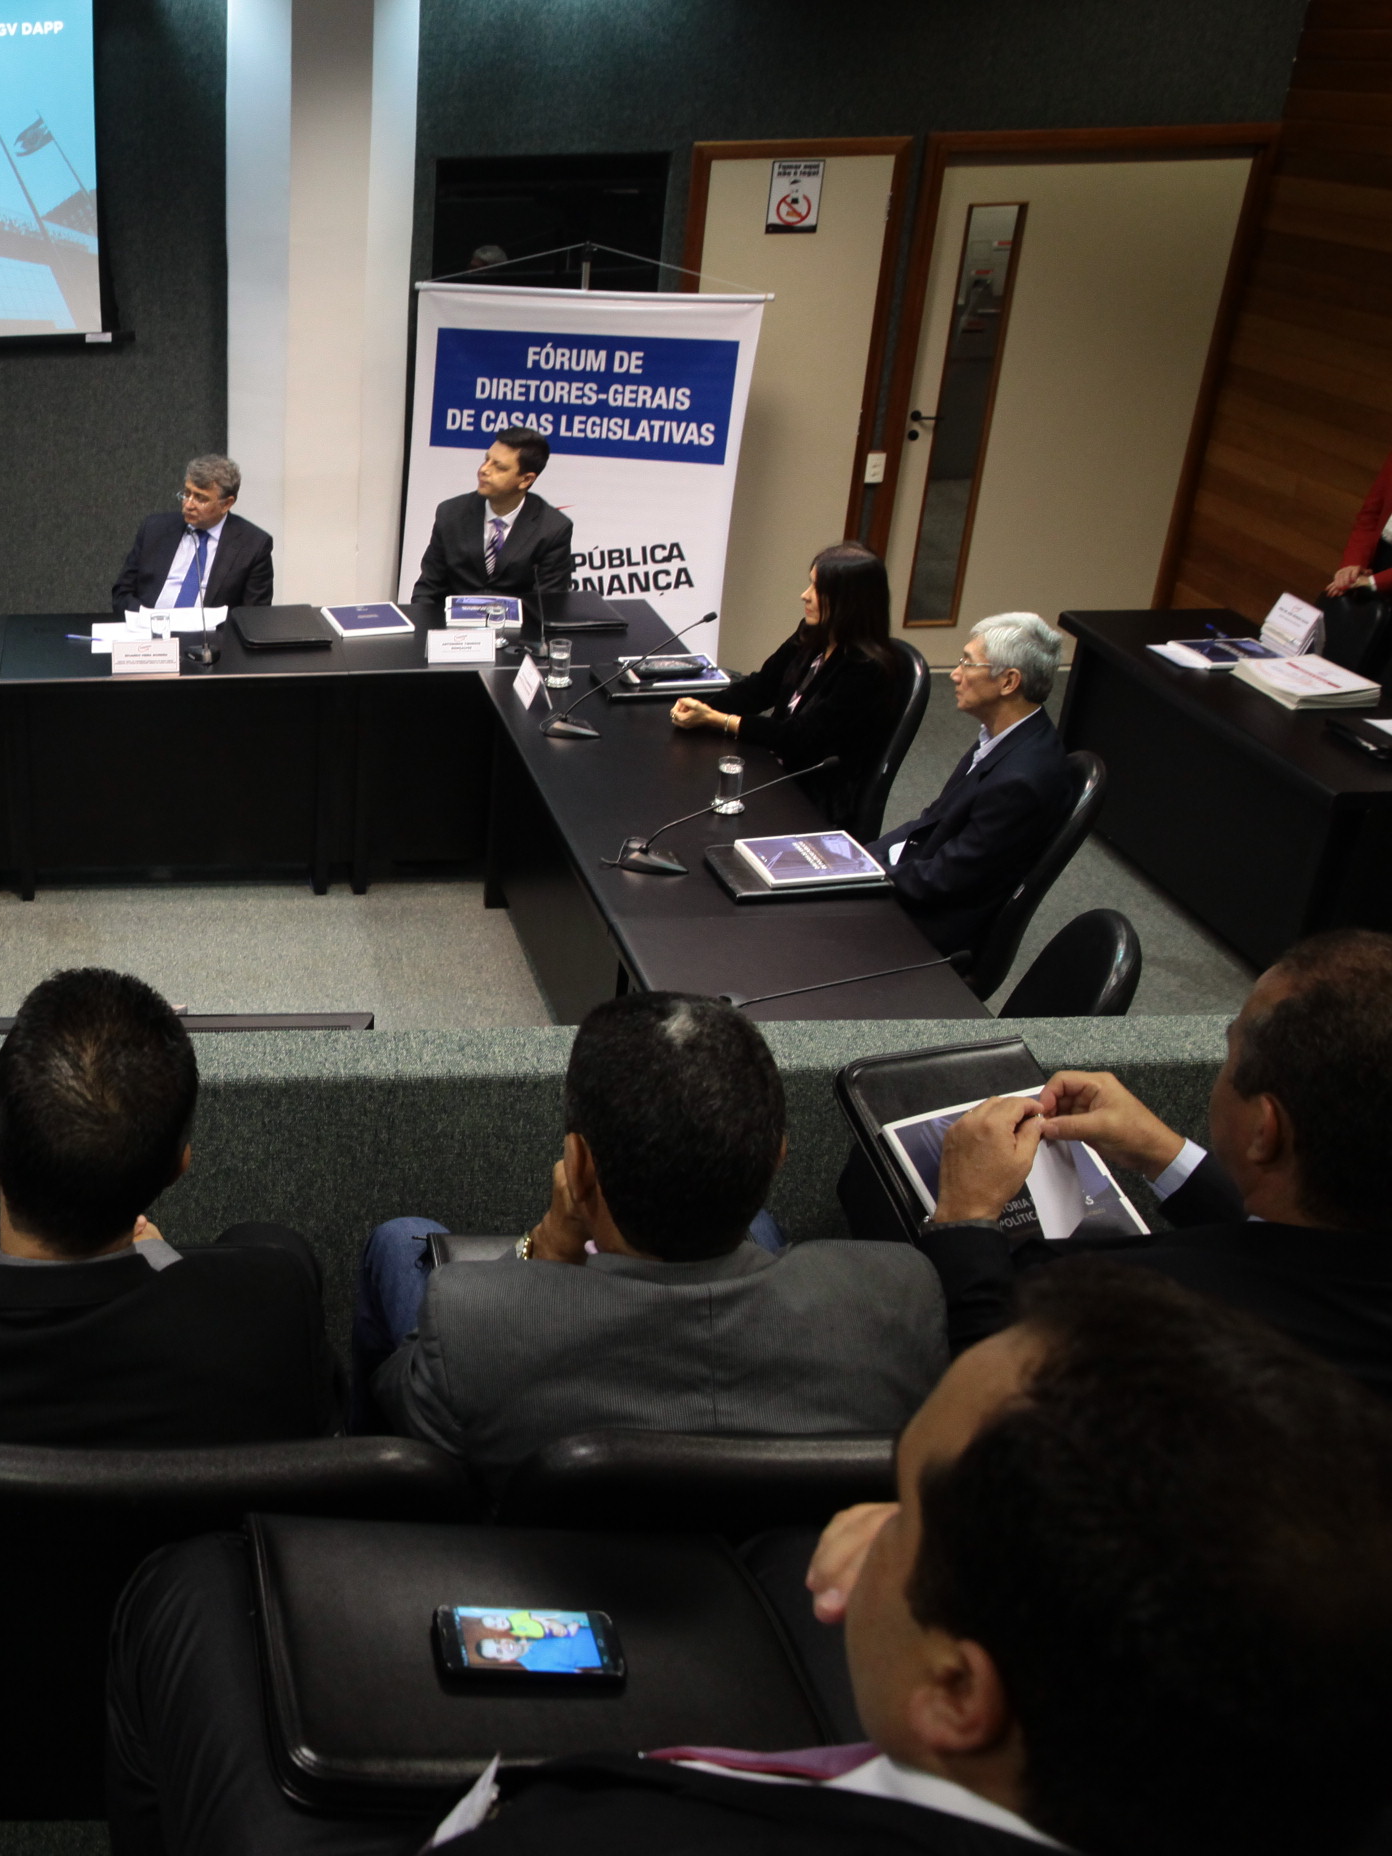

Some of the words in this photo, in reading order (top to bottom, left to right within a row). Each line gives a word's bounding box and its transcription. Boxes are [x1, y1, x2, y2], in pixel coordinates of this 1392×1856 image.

[21, 20, 64, 36] DAPP
[526, 342, 607, 373] FÓRUM
[613, 351, 644, 374] DE
[475, 377, 691, 411] DIRETORES-GERAIS
[446, 408, 475, 431] DE
[480, 410, 554, 436] CASAS
[559, 414, 715, 446] LEGISLATIVAS
[570, 542, 686, 573] PÚBLICA
